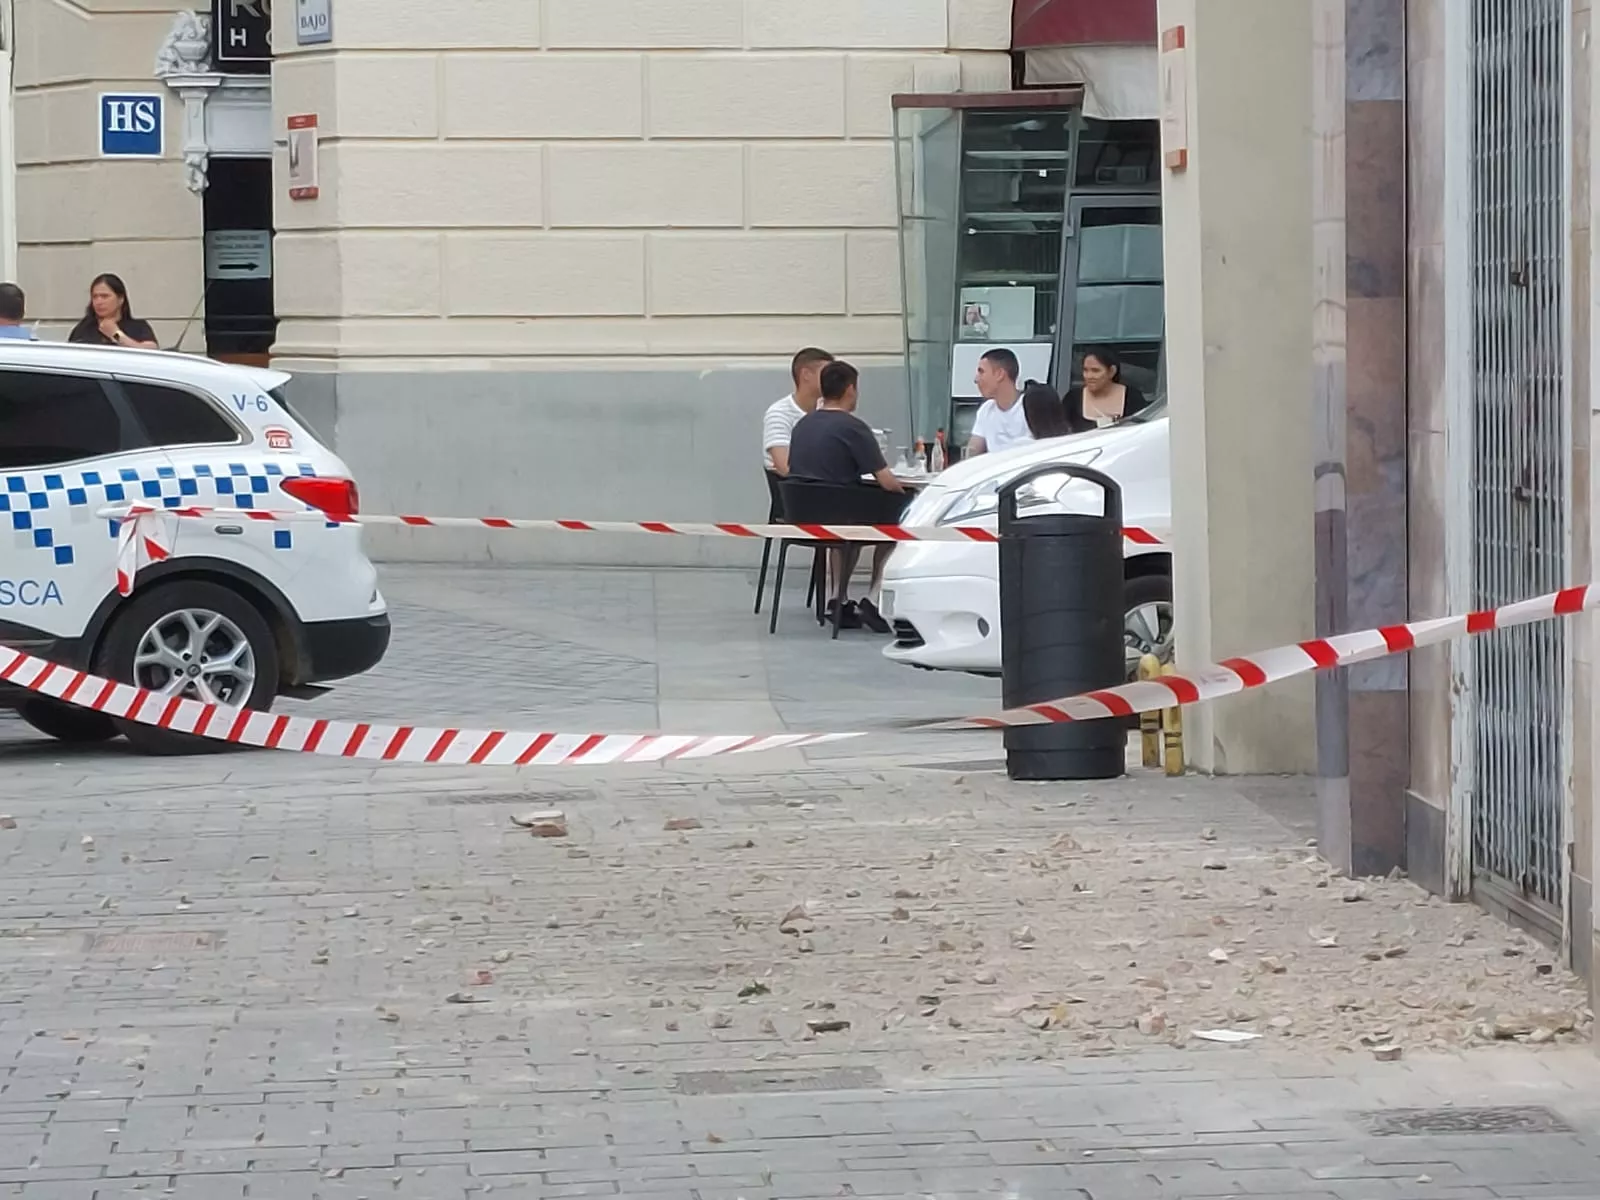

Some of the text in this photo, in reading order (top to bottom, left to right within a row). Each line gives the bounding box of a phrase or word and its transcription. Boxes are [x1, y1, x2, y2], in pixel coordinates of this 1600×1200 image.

[300, 14, 327, 30] BAJO
[107, 101, 155, 132] HS
[232, 394, 268, 412] V-6
[0, 580, 63, 605] SCA
